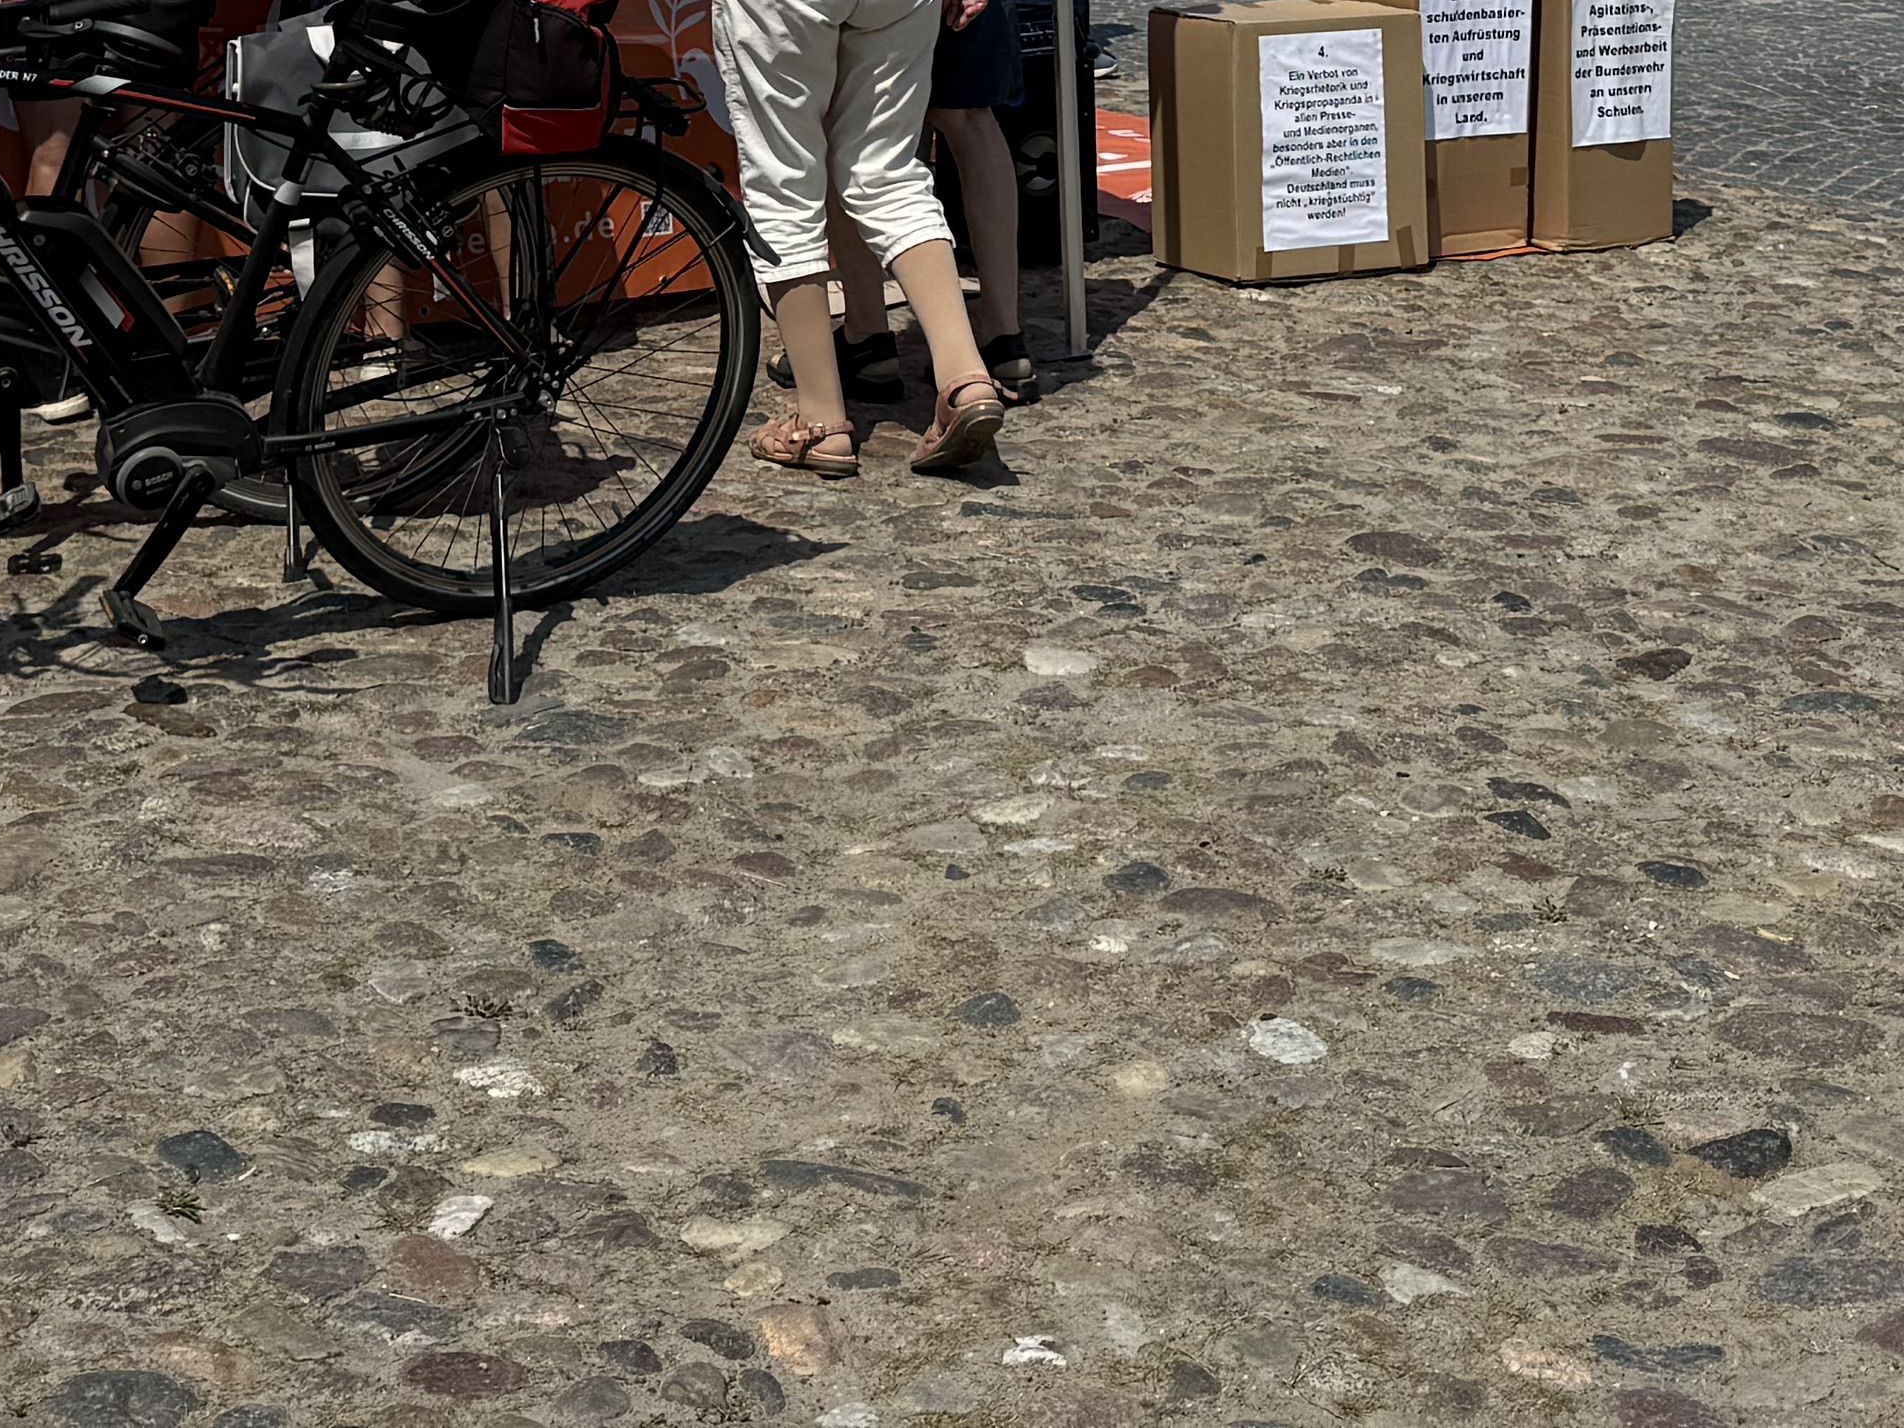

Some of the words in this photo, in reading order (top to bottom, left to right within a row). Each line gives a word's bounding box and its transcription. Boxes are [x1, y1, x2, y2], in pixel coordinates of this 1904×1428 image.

[1452, 28, 1521, 42] Aufrüstung
[1318, 46, 1329, 58] 4.
[1462, 49, 1484, 62] und
[1288, 71, 1305, 82] Ein
[1307, 69, 1339, 80] Verbot
[1575, 67, 1592, 79] der
[1596, 61, 1665, 77] Bundeswehr
[1423, 68, 1525, 87] Kriegswirtschaft
[1350, 80, 1369, 91] und
[1590, 88, 1604, 99] an
[1608, 84, 1652, 97] unseren
[1274, 95, 1362, 112] Kriegspropaganda
[1436, 93, 1448, 105] in
[1283, 127, 1302, 138] und
[1272, 140, 1324, 153] besonders
[1326, 138, 1347, 149] aber
[1349, 137, 1359, 147] in
[1361, 135, 1378, 146] den
[1287, 180, 1347, 194] Deutschland
[1350, 179, 1376, 189] muss
[1276, 196, 1301, 209] nicht
